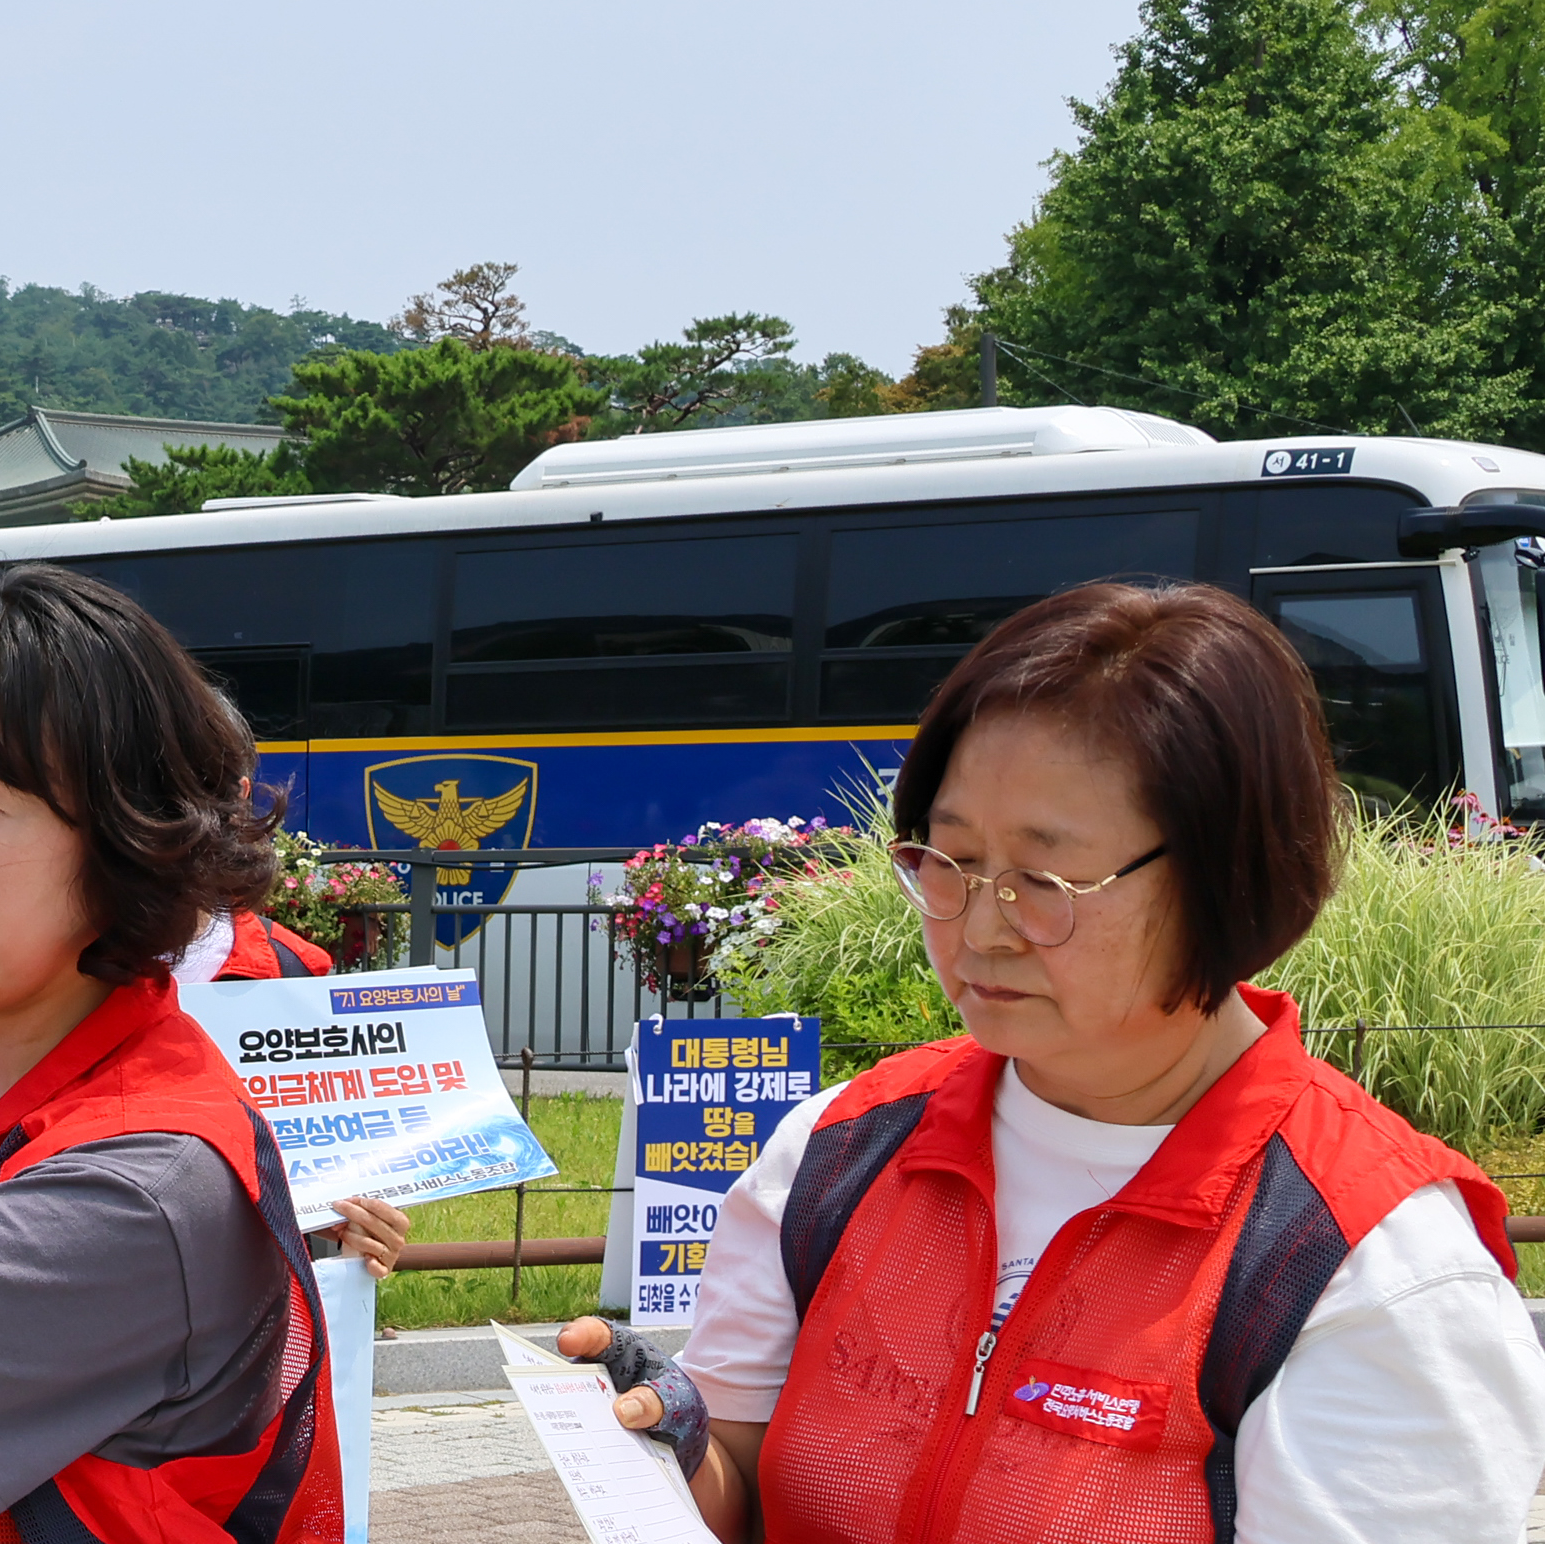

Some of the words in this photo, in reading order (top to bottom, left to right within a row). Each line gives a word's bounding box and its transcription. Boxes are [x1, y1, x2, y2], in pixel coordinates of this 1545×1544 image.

[1295, 452, 1345, 470] 41-1
[359, 985, 445, 1007] 요양보호사의
[446, 984, 466, 1002] 날"
[239, 1021, 407, 1064] 요양보호사의
[671, 1036, 789, 1068] 대통령님
[242, 1069, 366, 1109] 임금체계
[369, 1063, 432, 1098] 도입
[433, 1060, 469, 1092] 및
[646, 1072, 726, 1103] 나라에
[733, 1070, 811, 1102] 강제로
[268, 1109, 399, 1151] 절상여금
[400, 1105, 433, 1136] 등
[703, 1107, 756, 1138] 땅을
[638, 1283, 675, 1313] 되찾을
[679, 1283, 691, 1313] 수
